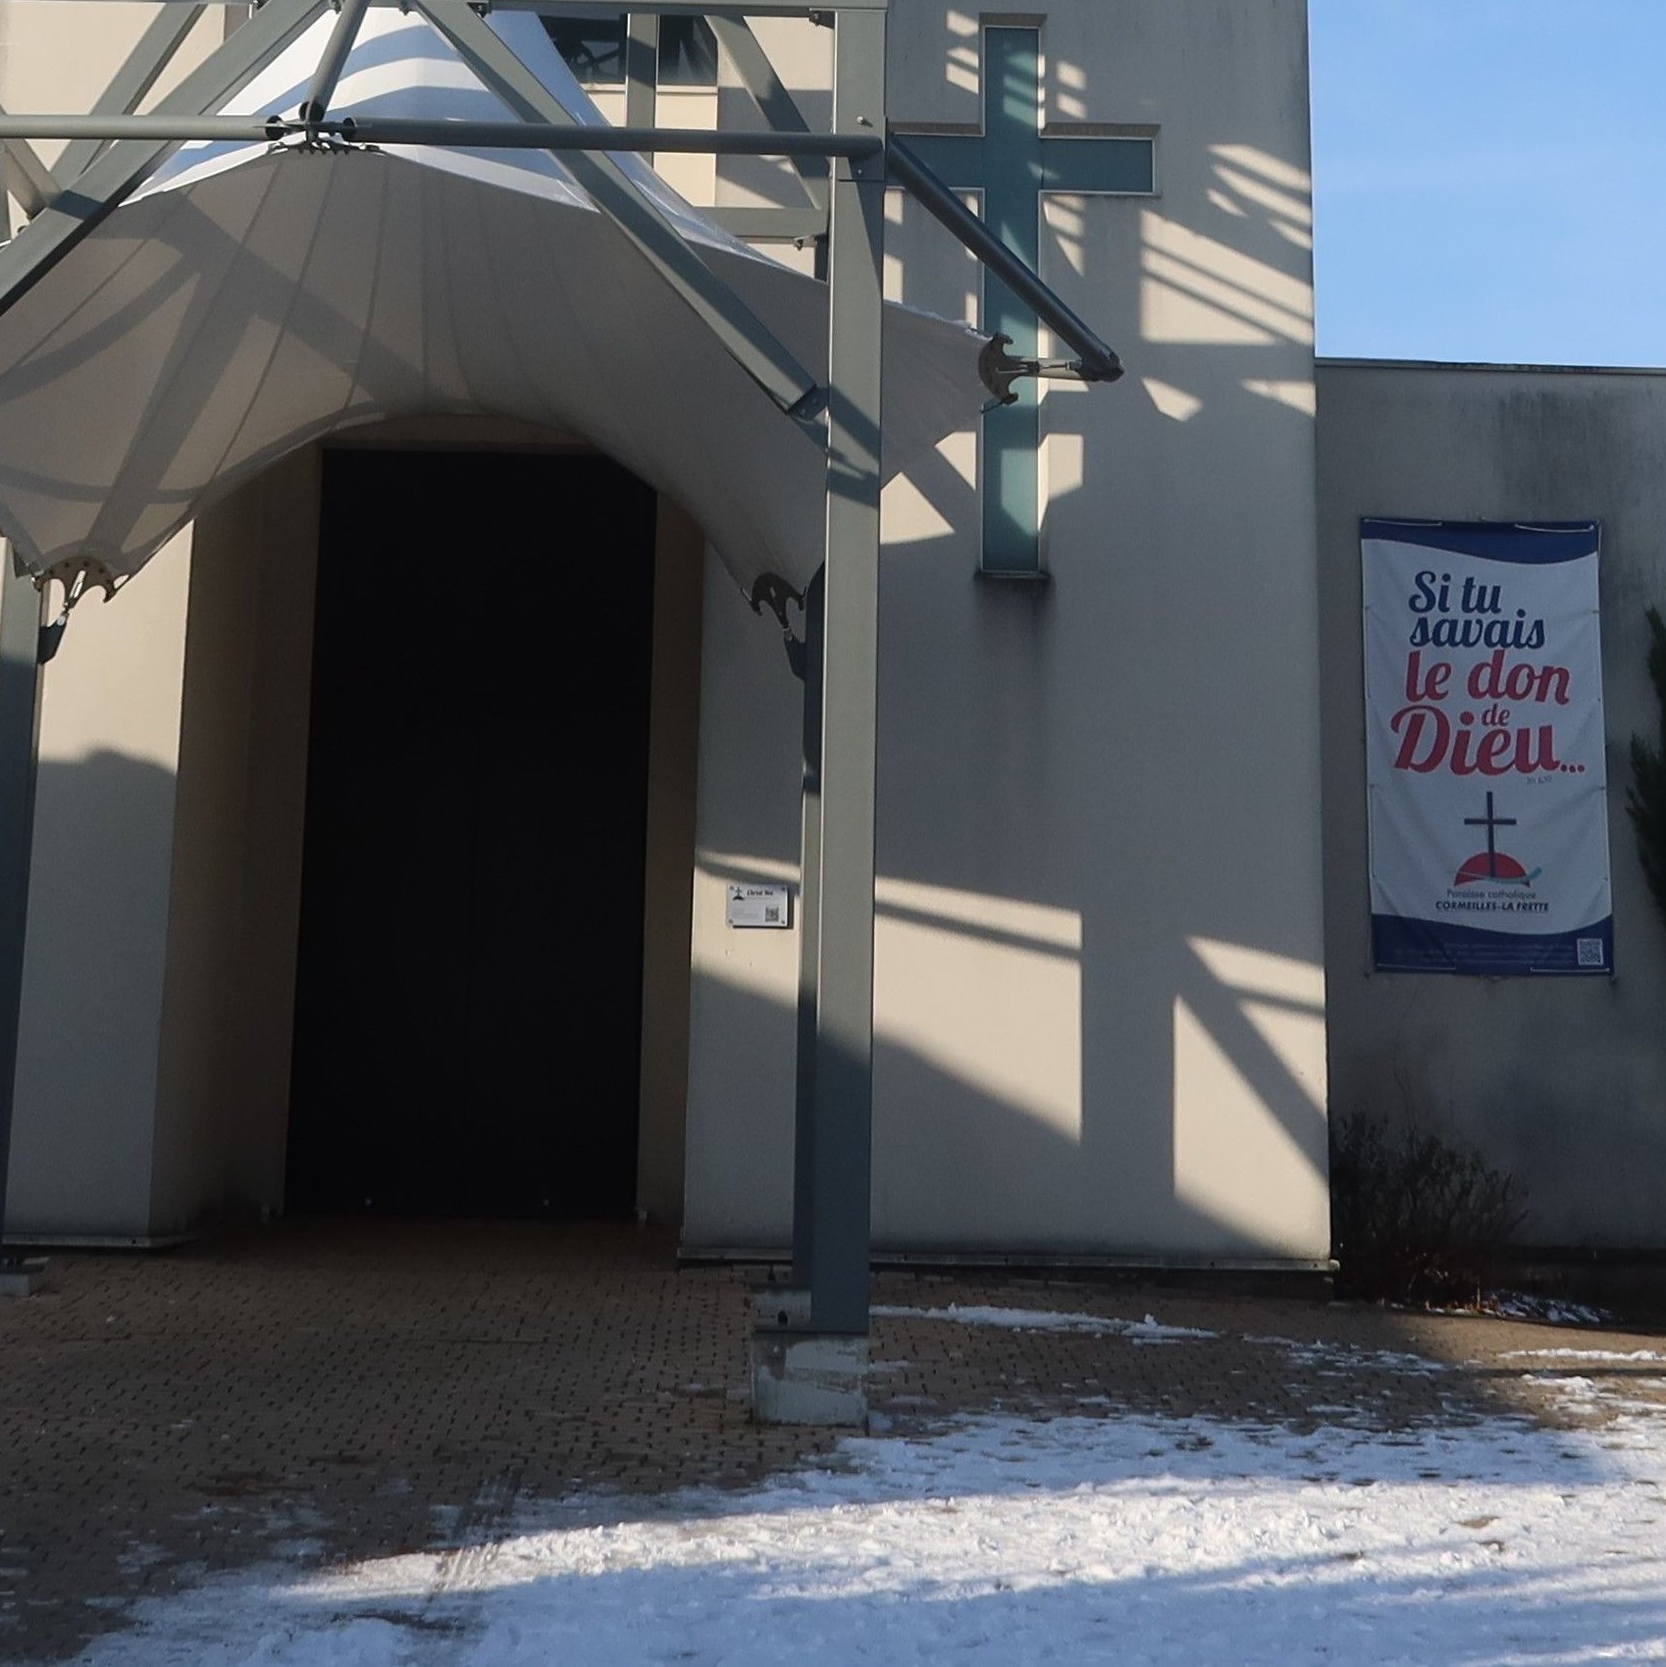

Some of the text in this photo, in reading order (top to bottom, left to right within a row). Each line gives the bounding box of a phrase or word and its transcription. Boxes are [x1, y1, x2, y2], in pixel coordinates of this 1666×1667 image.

[1408, 571, 1502, 614] Si tu
[1409, 609, 1546, 649] savais
[1406, 649, 1571, 705] le don
[1482, 703, 1511, 727] de
[1390, 704, 1586, 776] Dieu...
[1446, 888, 1537, 899] Paroisse catholique
[1517, 902, 1549, 911] FRETTE
